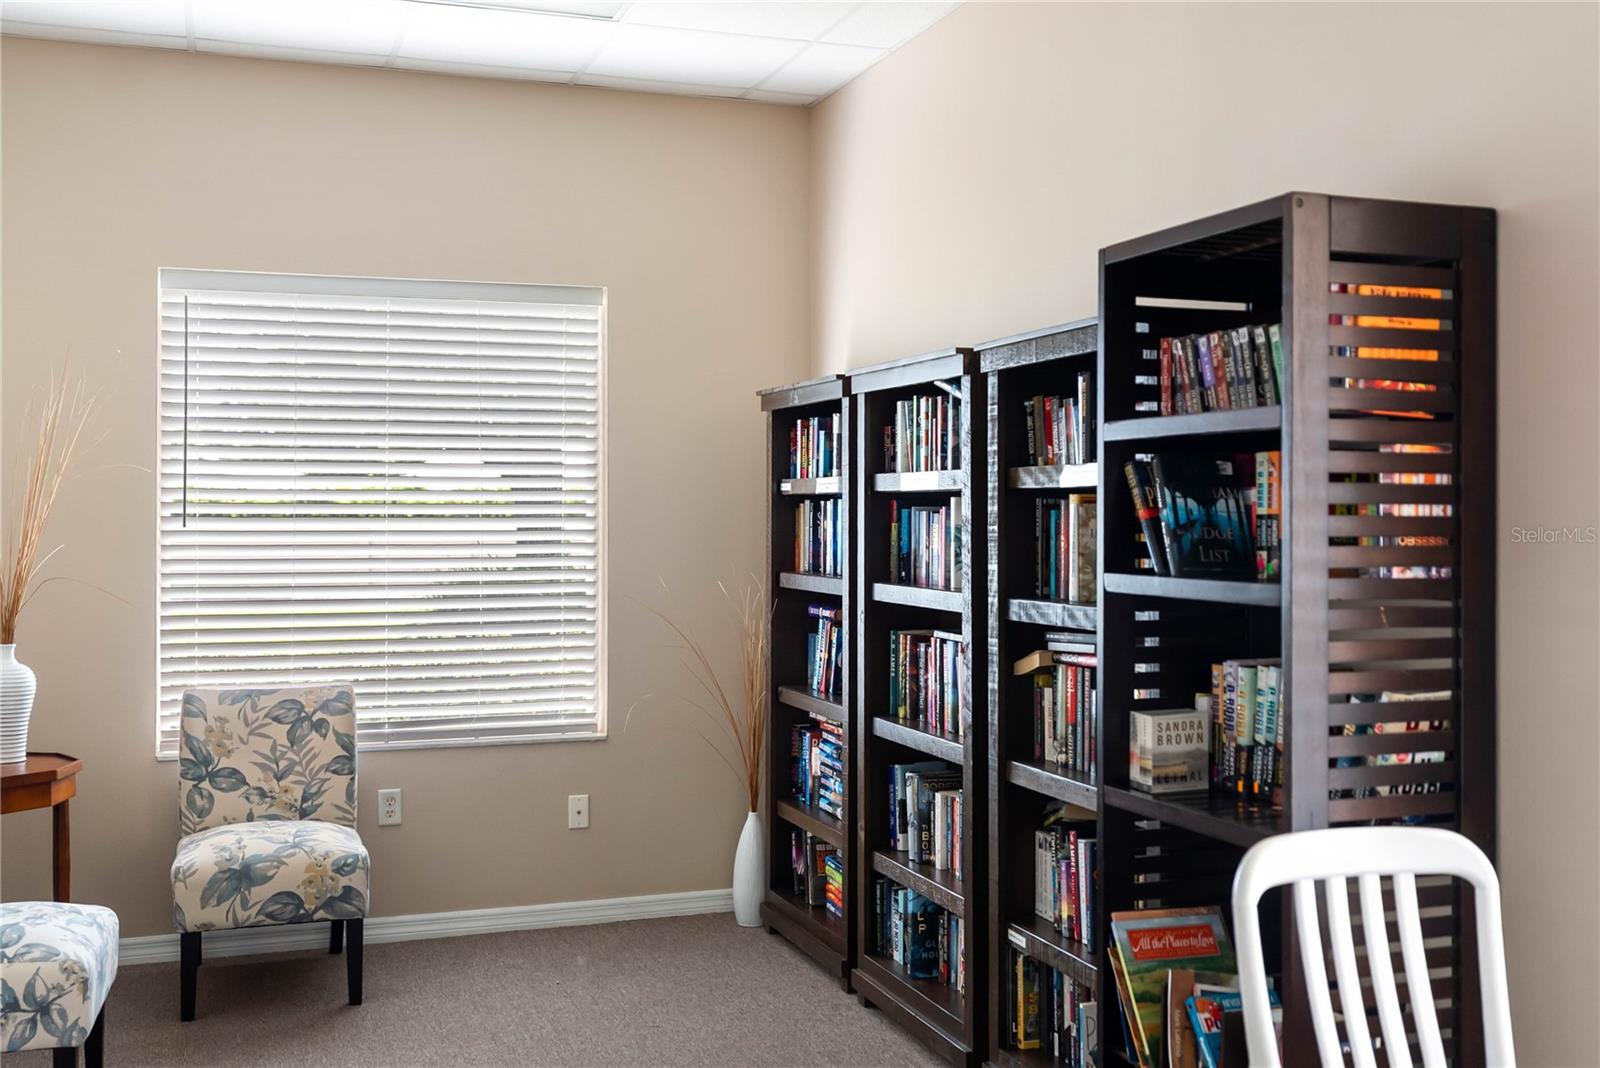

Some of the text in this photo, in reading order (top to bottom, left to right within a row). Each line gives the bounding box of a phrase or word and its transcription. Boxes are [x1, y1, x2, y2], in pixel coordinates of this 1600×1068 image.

[1198, 545, 1229, 562] LIST
[1157, 719, 1203, 733] SANDRA
[1157, 732, 1204, 746] BROWN
[1132, 935, 1150, 952] All
[1152, 937, 1164, 948] the
[1164, 934, 1190, 948] Places
[1196, 932, 1214, 948] Love
